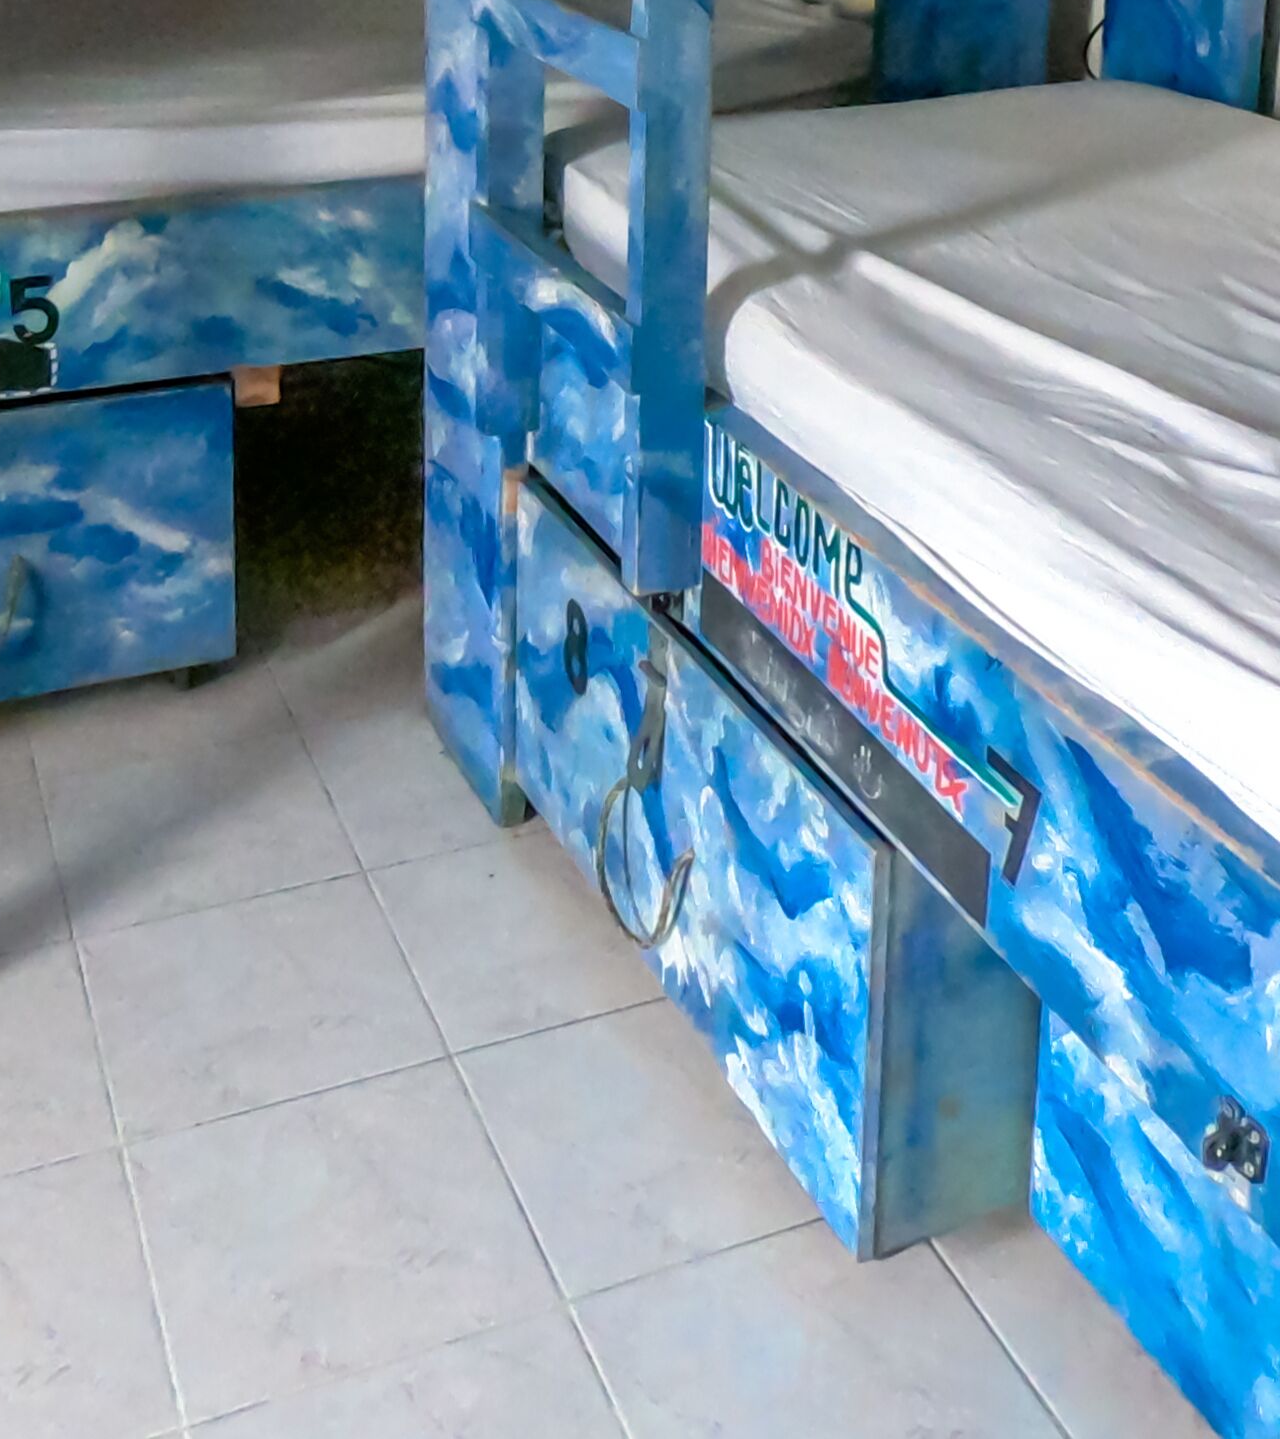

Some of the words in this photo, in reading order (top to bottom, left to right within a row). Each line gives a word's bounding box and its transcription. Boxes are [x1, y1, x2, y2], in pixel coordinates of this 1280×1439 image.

[9, 275, 60, 345] 5
[563, 598, 588, 696] 8
[759, 536, 881, 680] BIENVENUE
[986, 745, 1042, 886] 7
